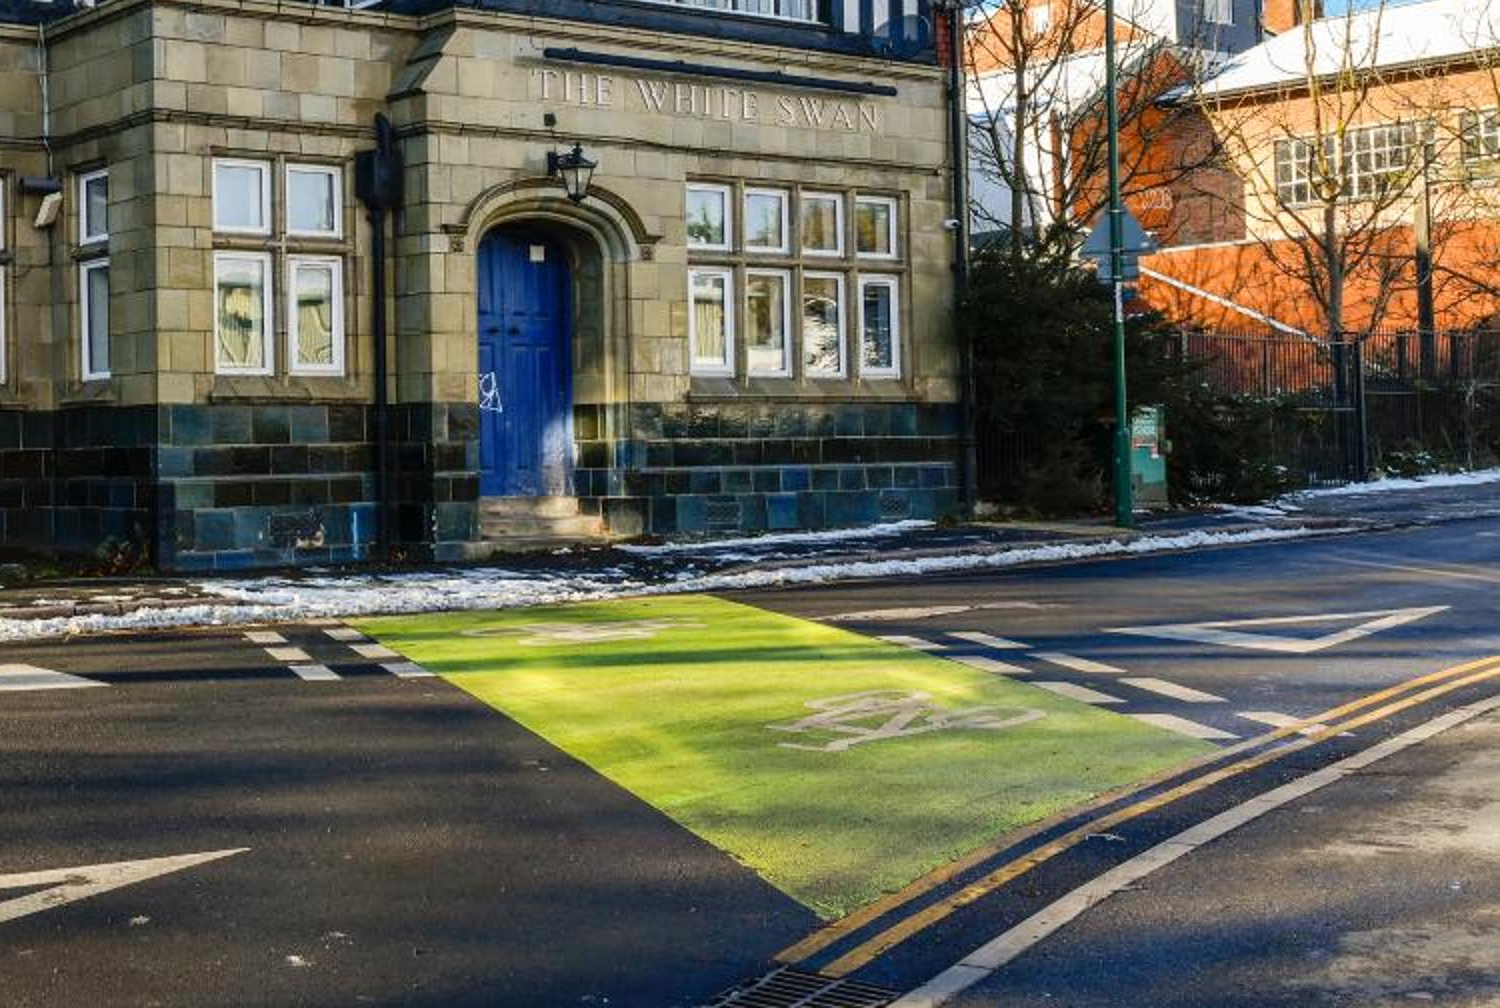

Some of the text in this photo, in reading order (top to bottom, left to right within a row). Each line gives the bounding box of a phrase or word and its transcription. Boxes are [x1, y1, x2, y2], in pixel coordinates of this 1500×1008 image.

[533, 68, 879, 131] THE WHITE SWAN
